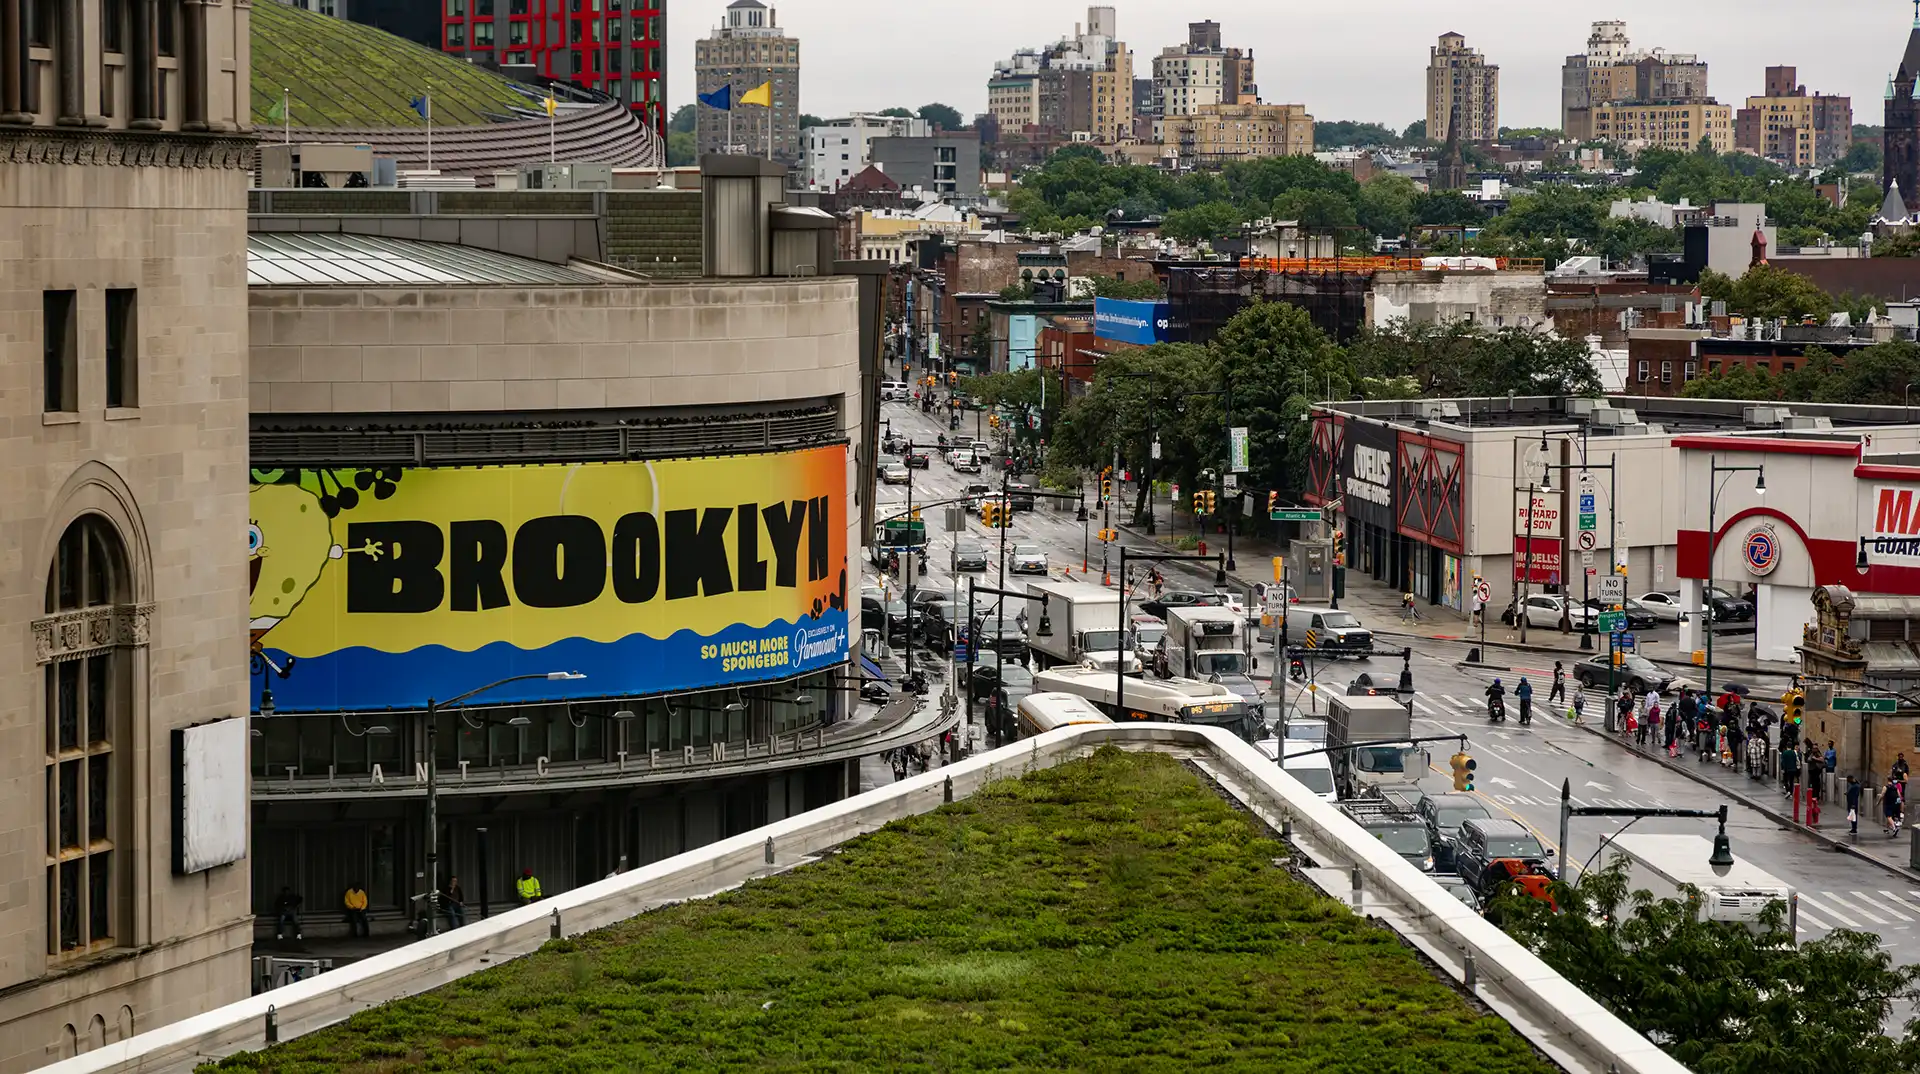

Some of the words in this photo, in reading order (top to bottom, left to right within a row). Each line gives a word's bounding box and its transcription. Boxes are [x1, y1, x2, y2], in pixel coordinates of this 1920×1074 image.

[1519, 508, 1558, 520] RIHARD
[1533, 520, 1552, 530] SON
[1874, 536, 1920, 556] GUAR
[347, 495, 829, 614] BROOKLYN
[1605, 580, 1618, 588] NO
[1272, 593, 1284, 601] NO
[1601, 589, 1623, 597] TURNS
[808, 628, 829, 638] EXCLUSIVELY
[830, 624, 836, 632] ON
[701, 645, 718, 660] SO
[720, 639, 757, 658] MUCH
[759, 635, 789, 653] MORE
[793, 627, 846, 668] Paramount+
[722, 650, 790, 673] SPONGEBOB
[1850, 700, 1859, 708] 4
[1862, 701, 1879, 709] Av
[285, 756, 549, 783] TLANTIC
[617, 728, 827, 773] TERMINAL
